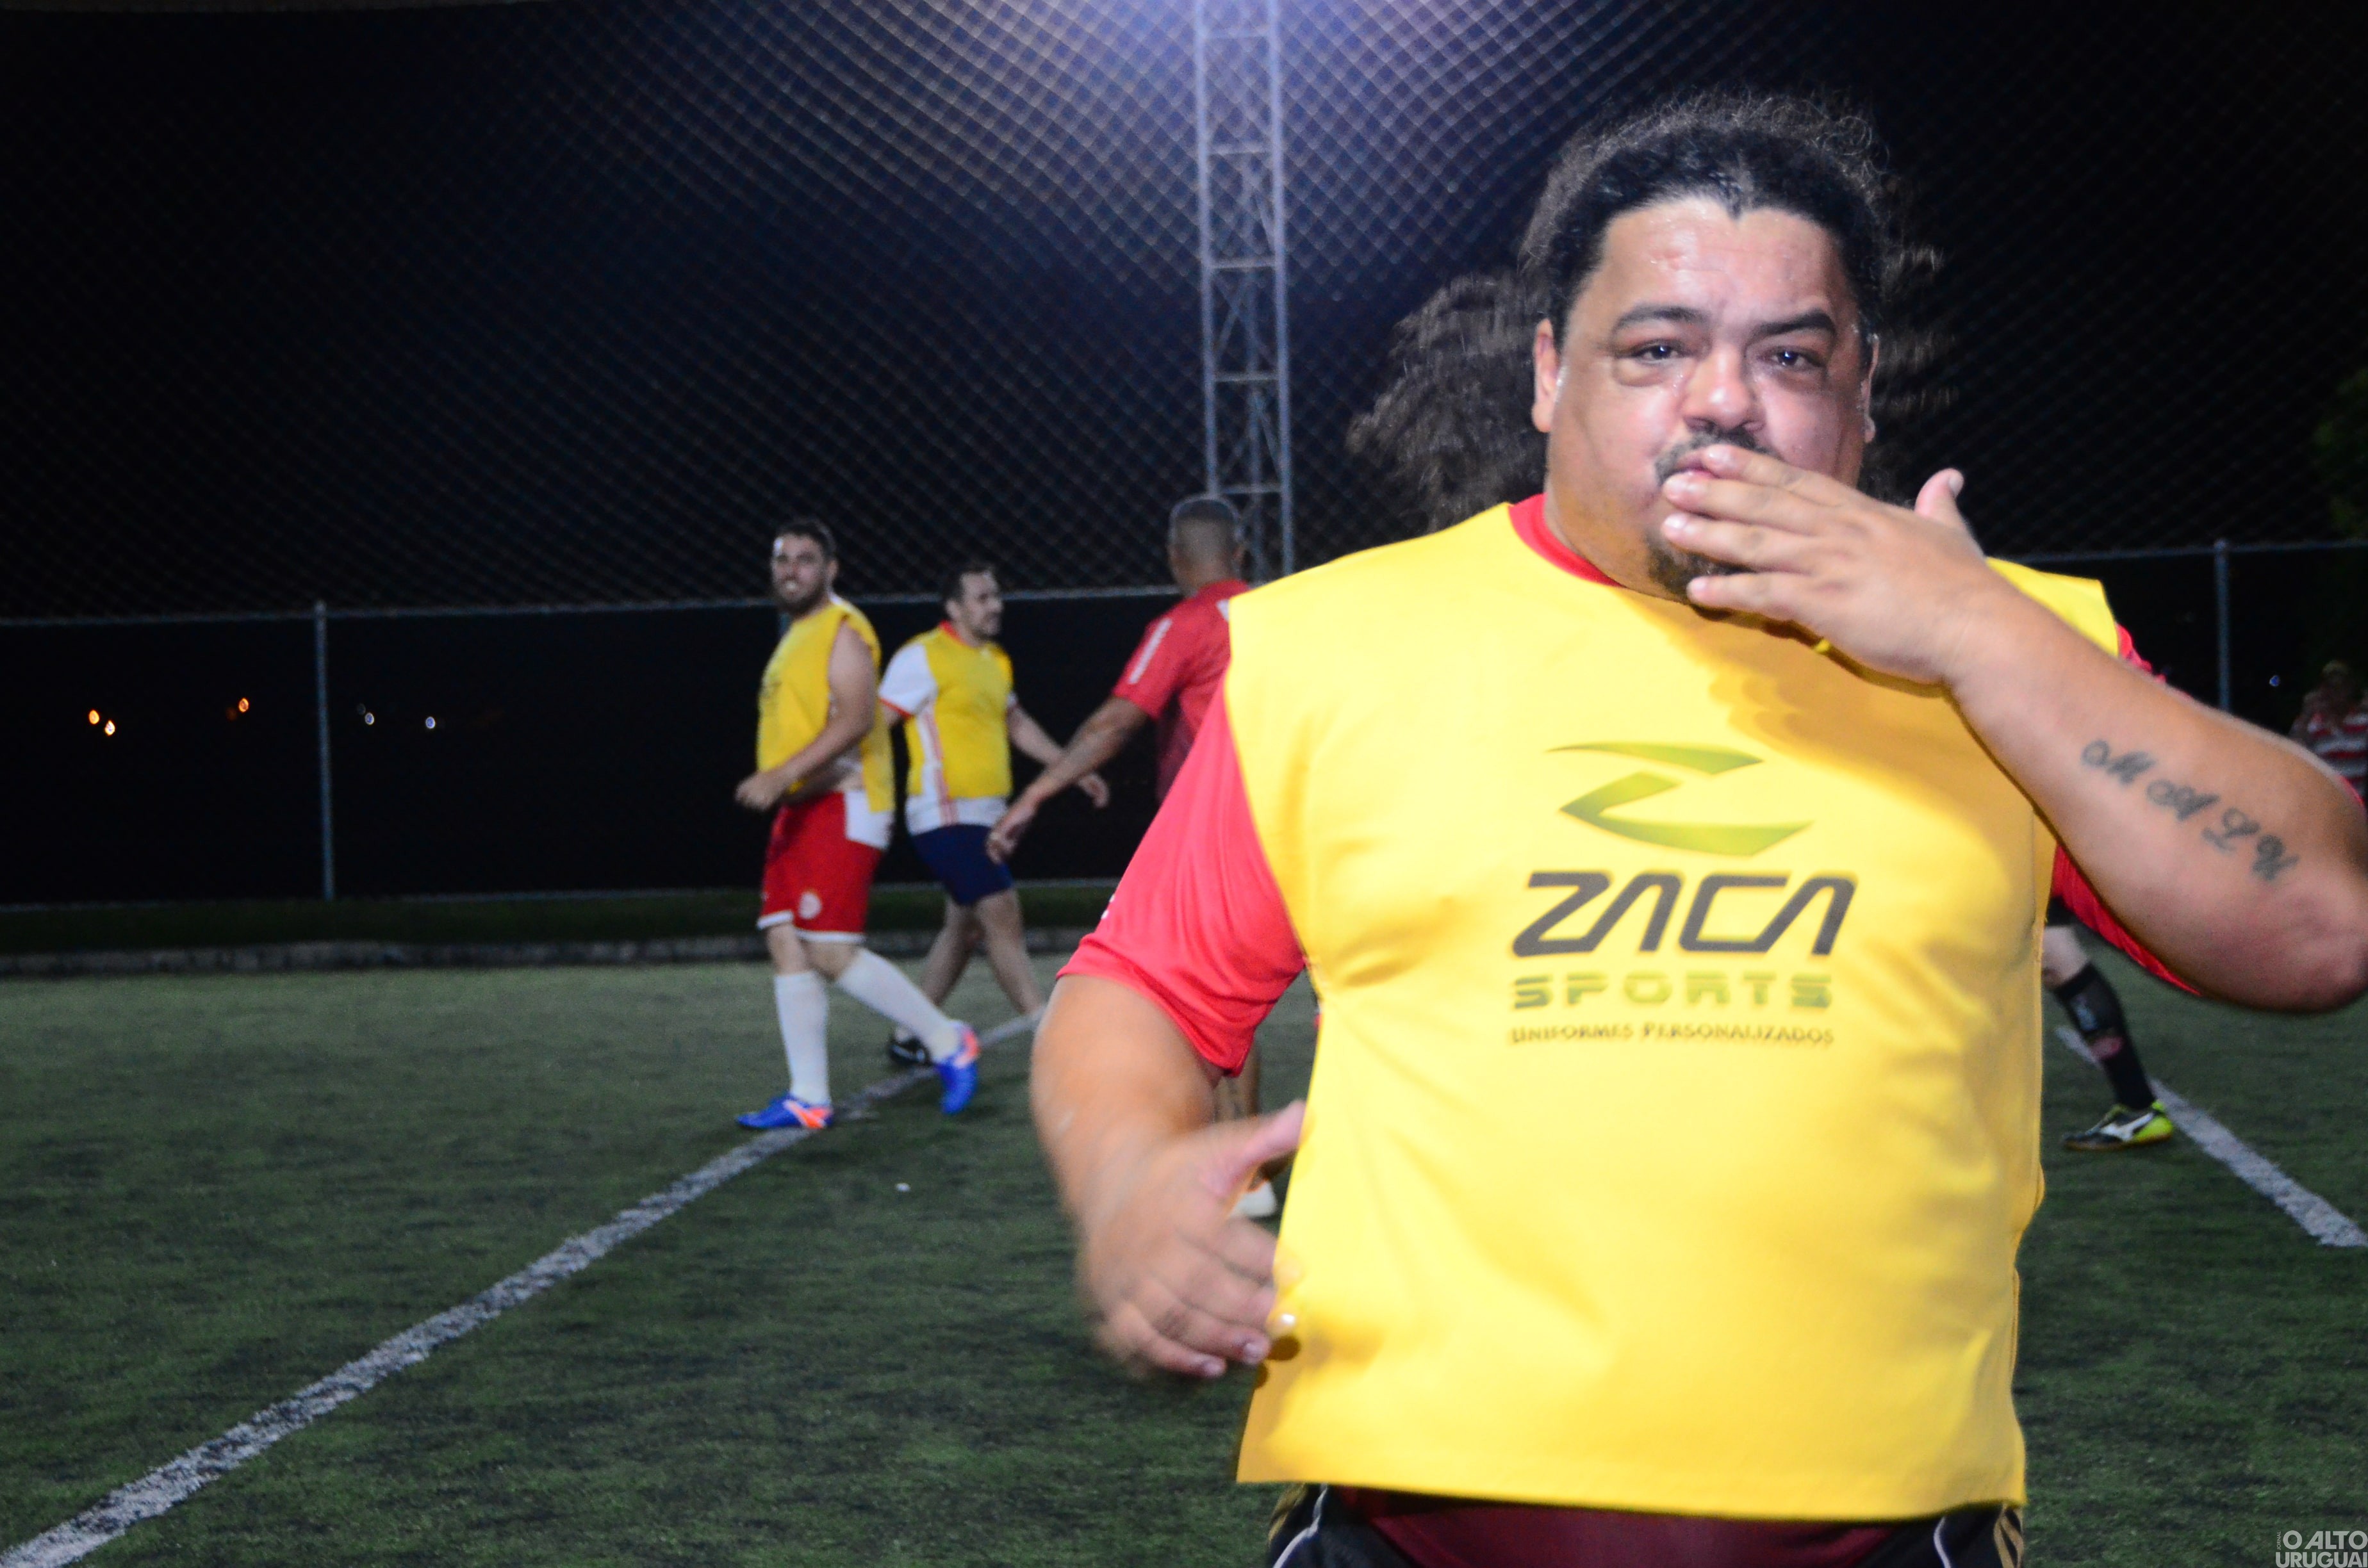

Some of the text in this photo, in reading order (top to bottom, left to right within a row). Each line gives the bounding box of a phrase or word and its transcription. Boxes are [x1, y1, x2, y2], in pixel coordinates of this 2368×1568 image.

[1514, 870, 1859, 957] ZACA
[1514, 972, 1832, 1008] SPORTS
[1512, 1022, 1834, 1044] UNIFORMES PERSONALIZADOS
